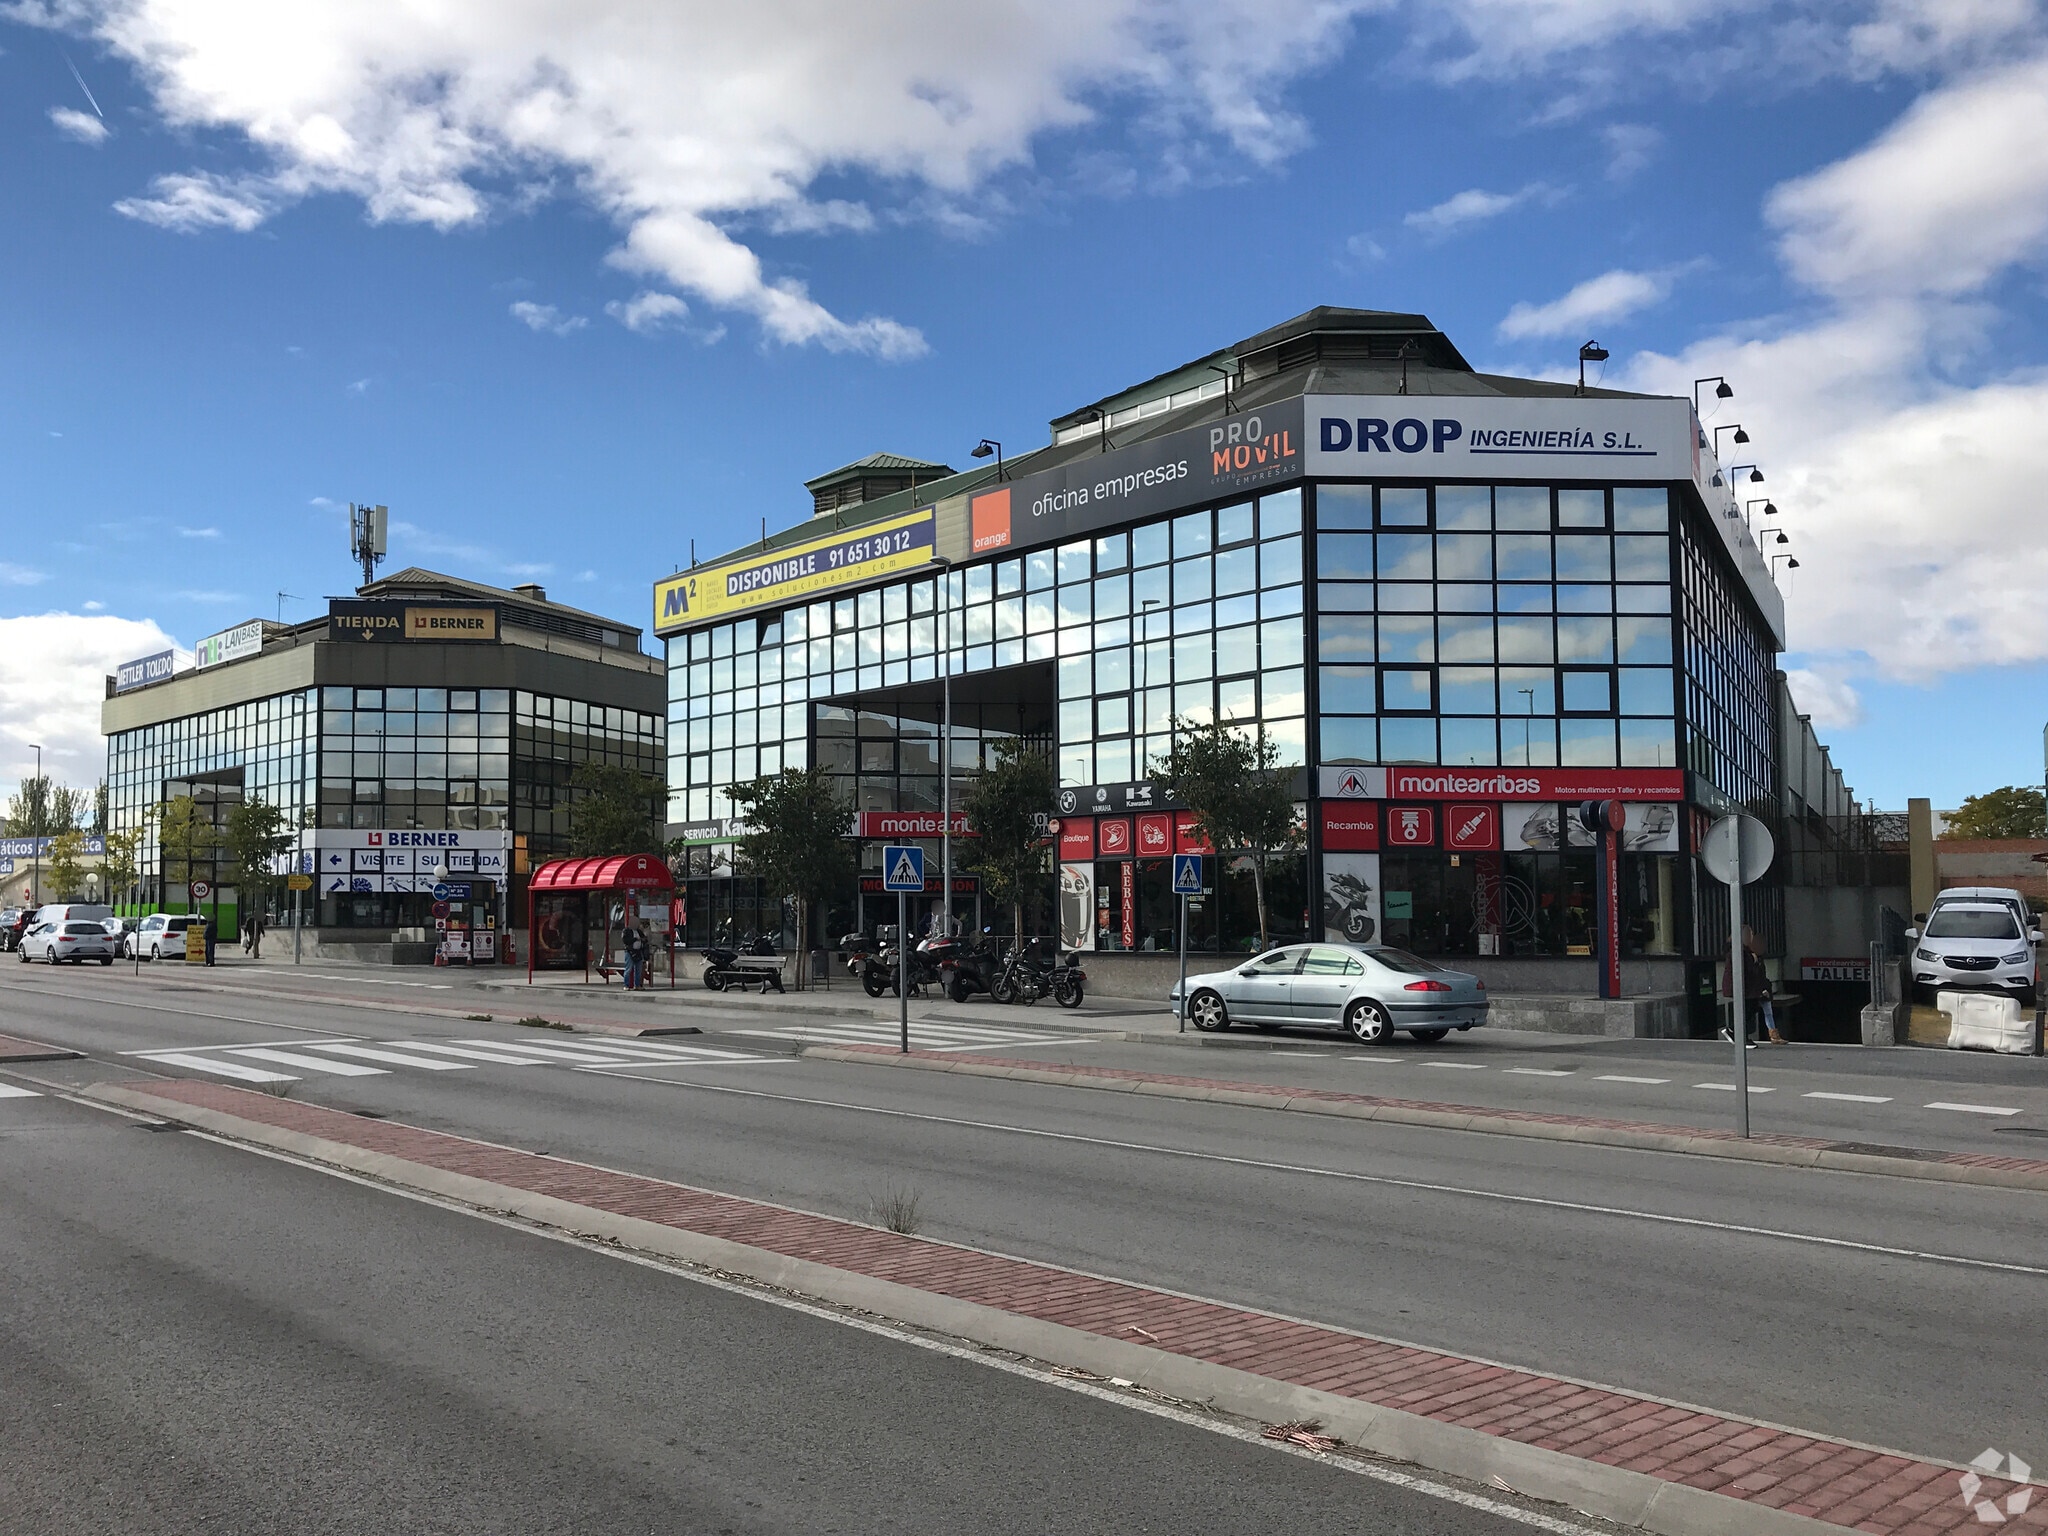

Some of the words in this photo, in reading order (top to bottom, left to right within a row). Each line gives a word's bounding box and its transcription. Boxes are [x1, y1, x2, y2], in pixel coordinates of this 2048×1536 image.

[1210, 416, 1263, 453] PRO
[1319, 418, 1463, 453] DROP
[1470, 427, 1595, 449] INGENIERÍA
[1603, 431, 1643, 450] S.L.
[1236, 464, 1297, 486] EMPRESAS
[1032, 486, 1089, 517] oficina
[1094, 459, 1188, 500] empresas
[974, 531, 1007, 548] orange
[728, 554, 816, 594] DISPONIBLE
[829, 549, 844, 568] 91
[847, 542, 870, 564] 651
[874, 538, 890, 557] 30
[894, 531, 910, 550] 12
[335, 616, 400, 628] TIENDA
[430, 617, 484, 630] BERNER
[117, 666, 144, 686] METTLER
[146, 656, 172, 678] TOLEDO
[1400, 774, 1541, 794] montearribas
[1555, 786, 1576, 794] Motos
[1577, 786, 1616, 794] multimarca
[1618, 786, 1636, 794] Taller
[1638, 787, 1643, 795] y
[1644, 786, 1681, 794] recambios
[1092, 804, 1112, 813] YAMAHA
[1126, 799, 1153, 808] Kawasaki
[683, 827, 718, 840] SERVICIO
[1327, 821, 1374, 831] Recambio
[388, 832, 460, 847] BERNER
[1063, 835, 1090, 844] Boutique
[361, 855, 405, 866] VISITE
[421, 855, 440, 866] SU
[451, 855, 501, 867] TIENDA
[195, 885, 206, 893] 30
[1122, 864, 1132, 945] REBAJAS
[1611, 859, 1620, 980] montearribas
